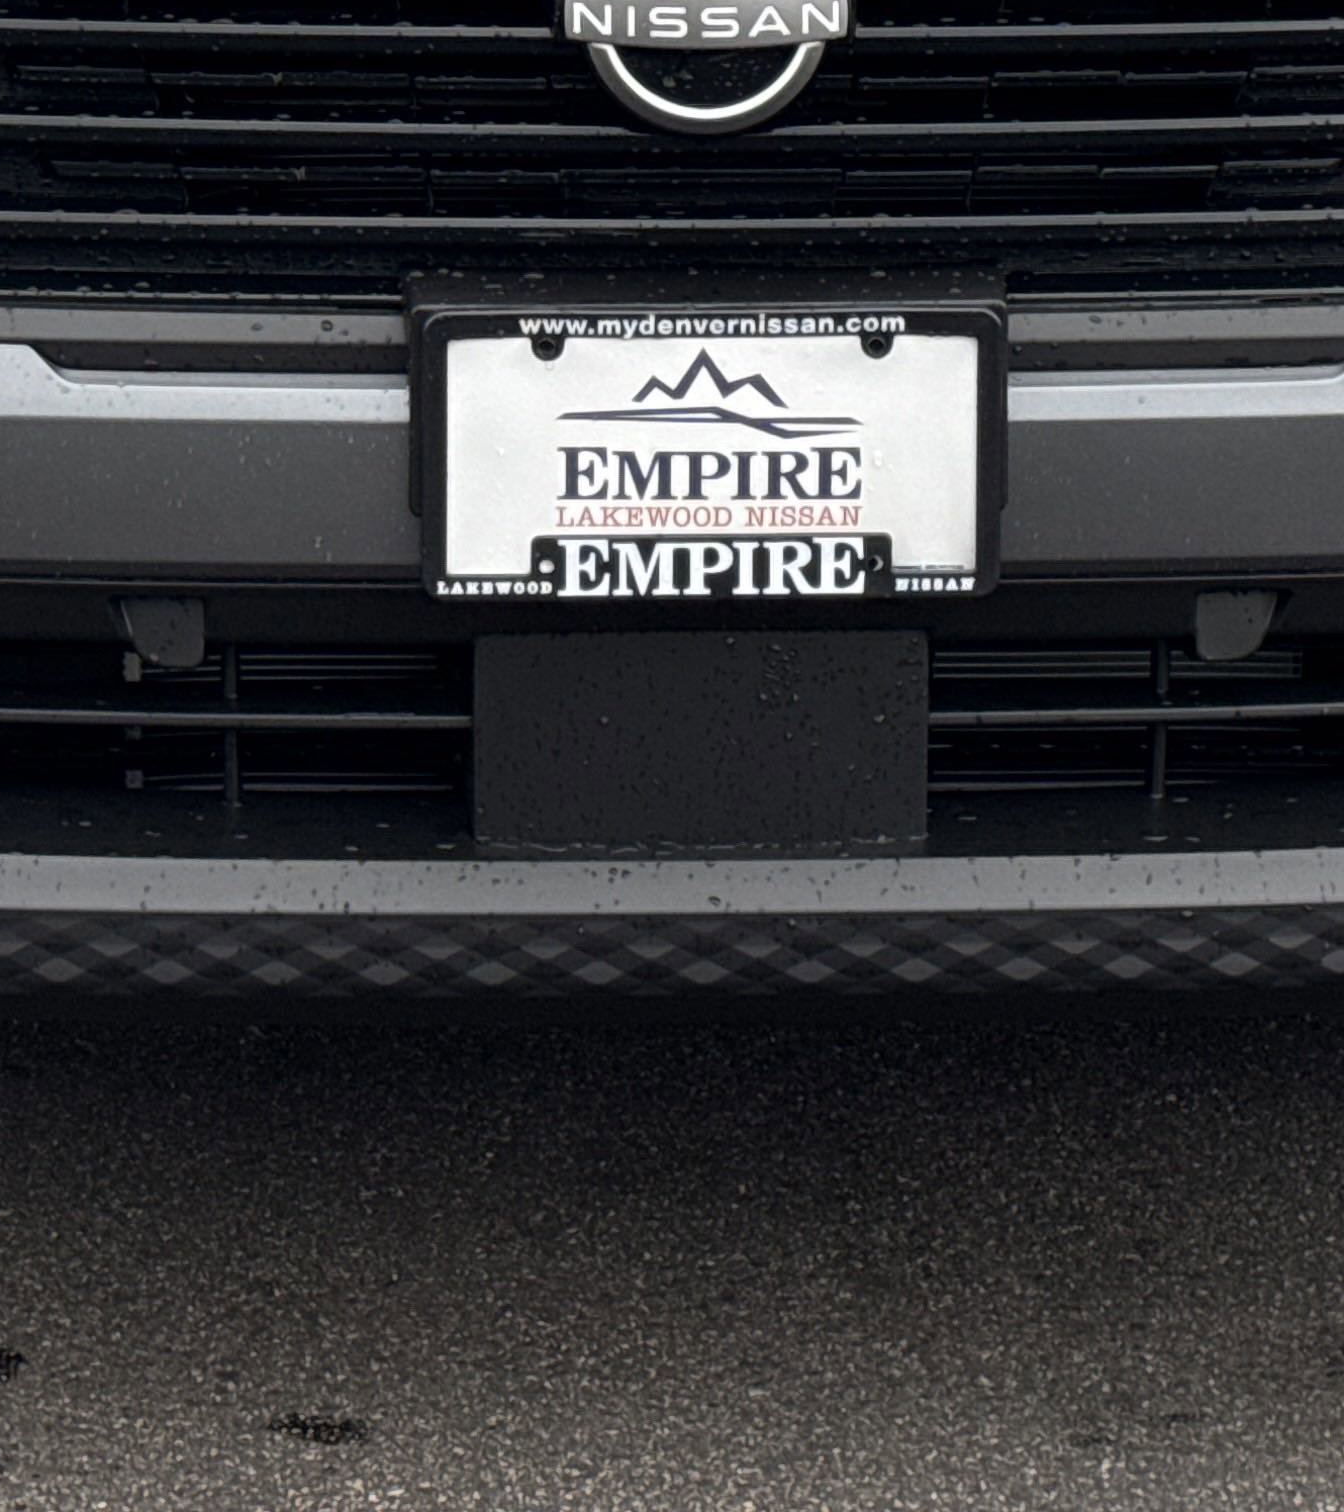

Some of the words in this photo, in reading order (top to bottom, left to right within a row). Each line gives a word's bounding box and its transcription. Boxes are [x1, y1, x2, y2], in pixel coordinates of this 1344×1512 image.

[572, 1, 840, 39] NISSAN
[518, 313, 906, 339] www.mydenvernissan.com
[556, 447, 862, 500] EMPIRE
[556, 506, 733, 528] LAKEWOOD
[744, 505, 863, 528] NISSAN
[436, 580, 554, 596] LAKEWOOD
[556, 536, 866, 597] EMPIRE
[894, 576, 976, 592] NISSAN
